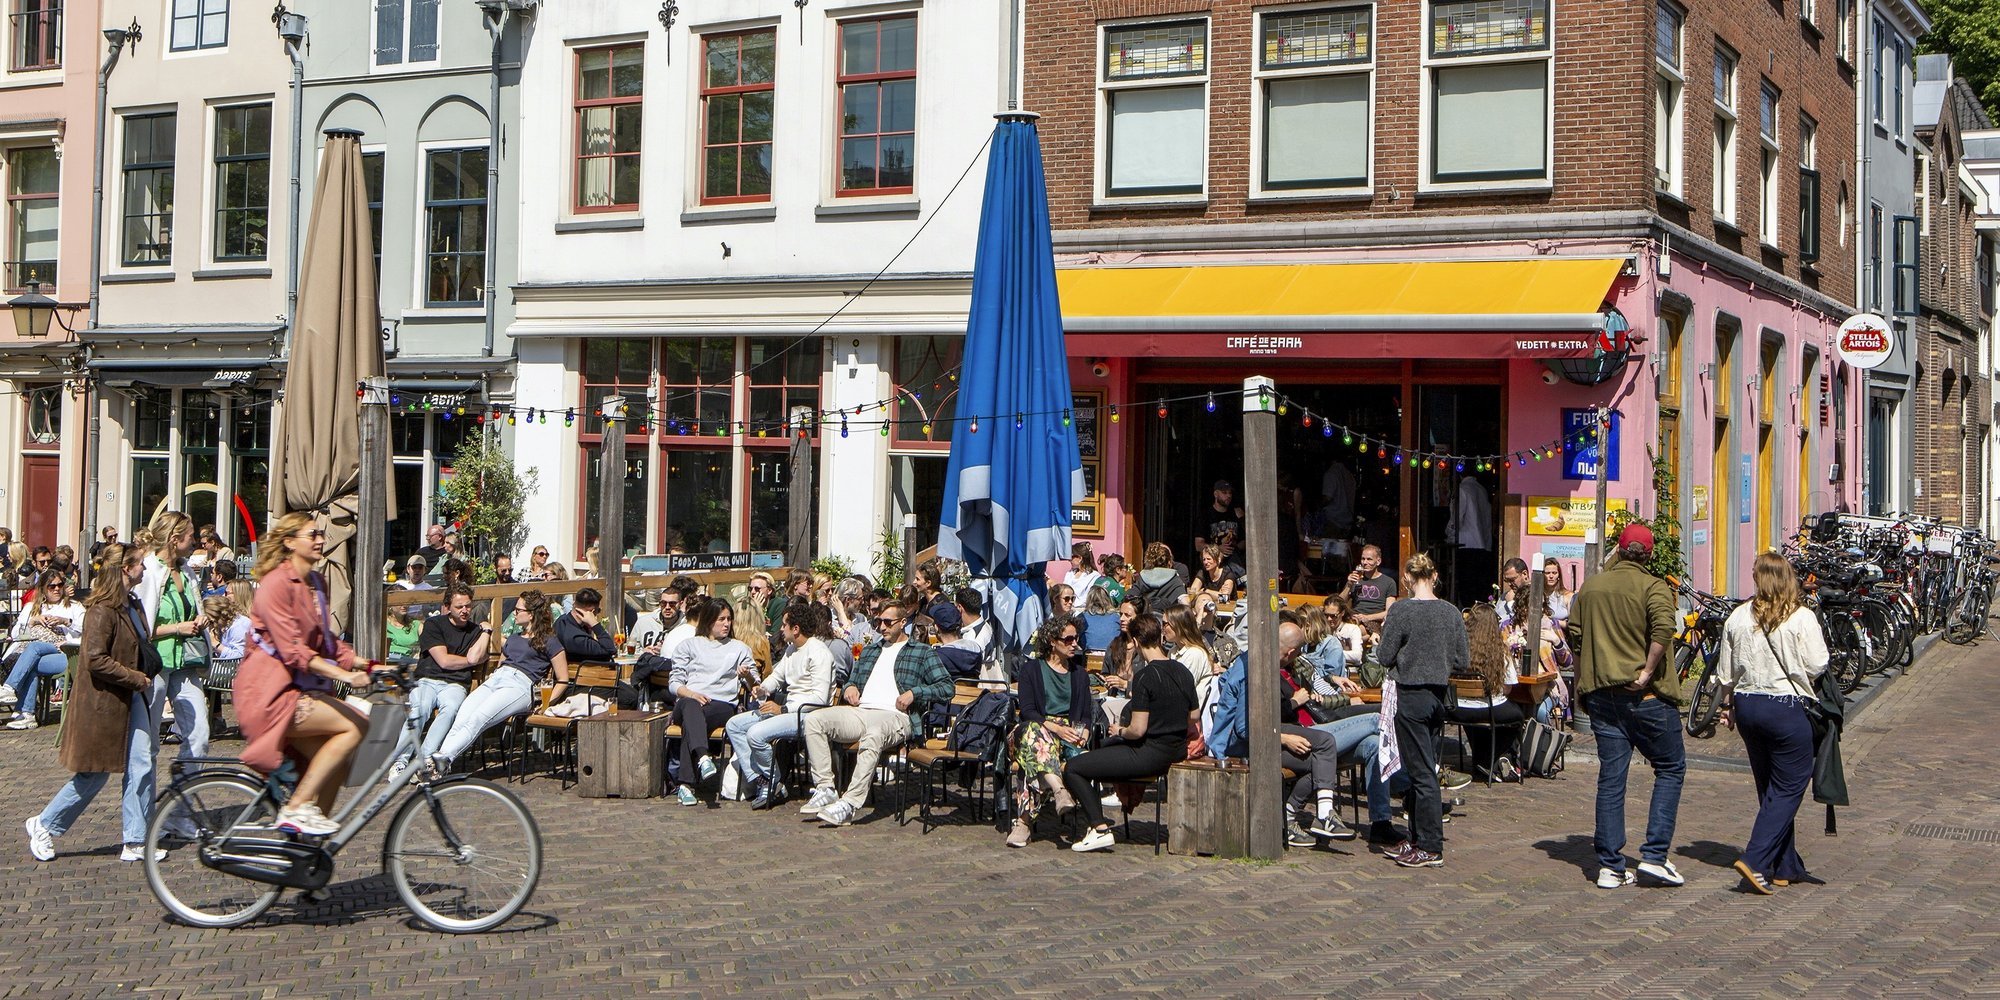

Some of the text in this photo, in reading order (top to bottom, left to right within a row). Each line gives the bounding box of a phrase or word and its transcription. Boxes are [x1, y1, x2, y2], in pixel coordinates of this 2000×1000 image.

[1226, 334, 1258, 348] CAFÉ
[1270, 337, 1303, 348] ZAAK
[1849, 333, 1880, 341] STELLA
[1516, 341, 1589, 349] VEDETT EXTRA
[1573, 413, 1598, 426] FOO
[1587, 448, 1598, 459] YO
[672, 555, 697, 569] FOOD?
[713, 555, 730, 567] YOUR
[731, 554, 748, 567] OWN!
